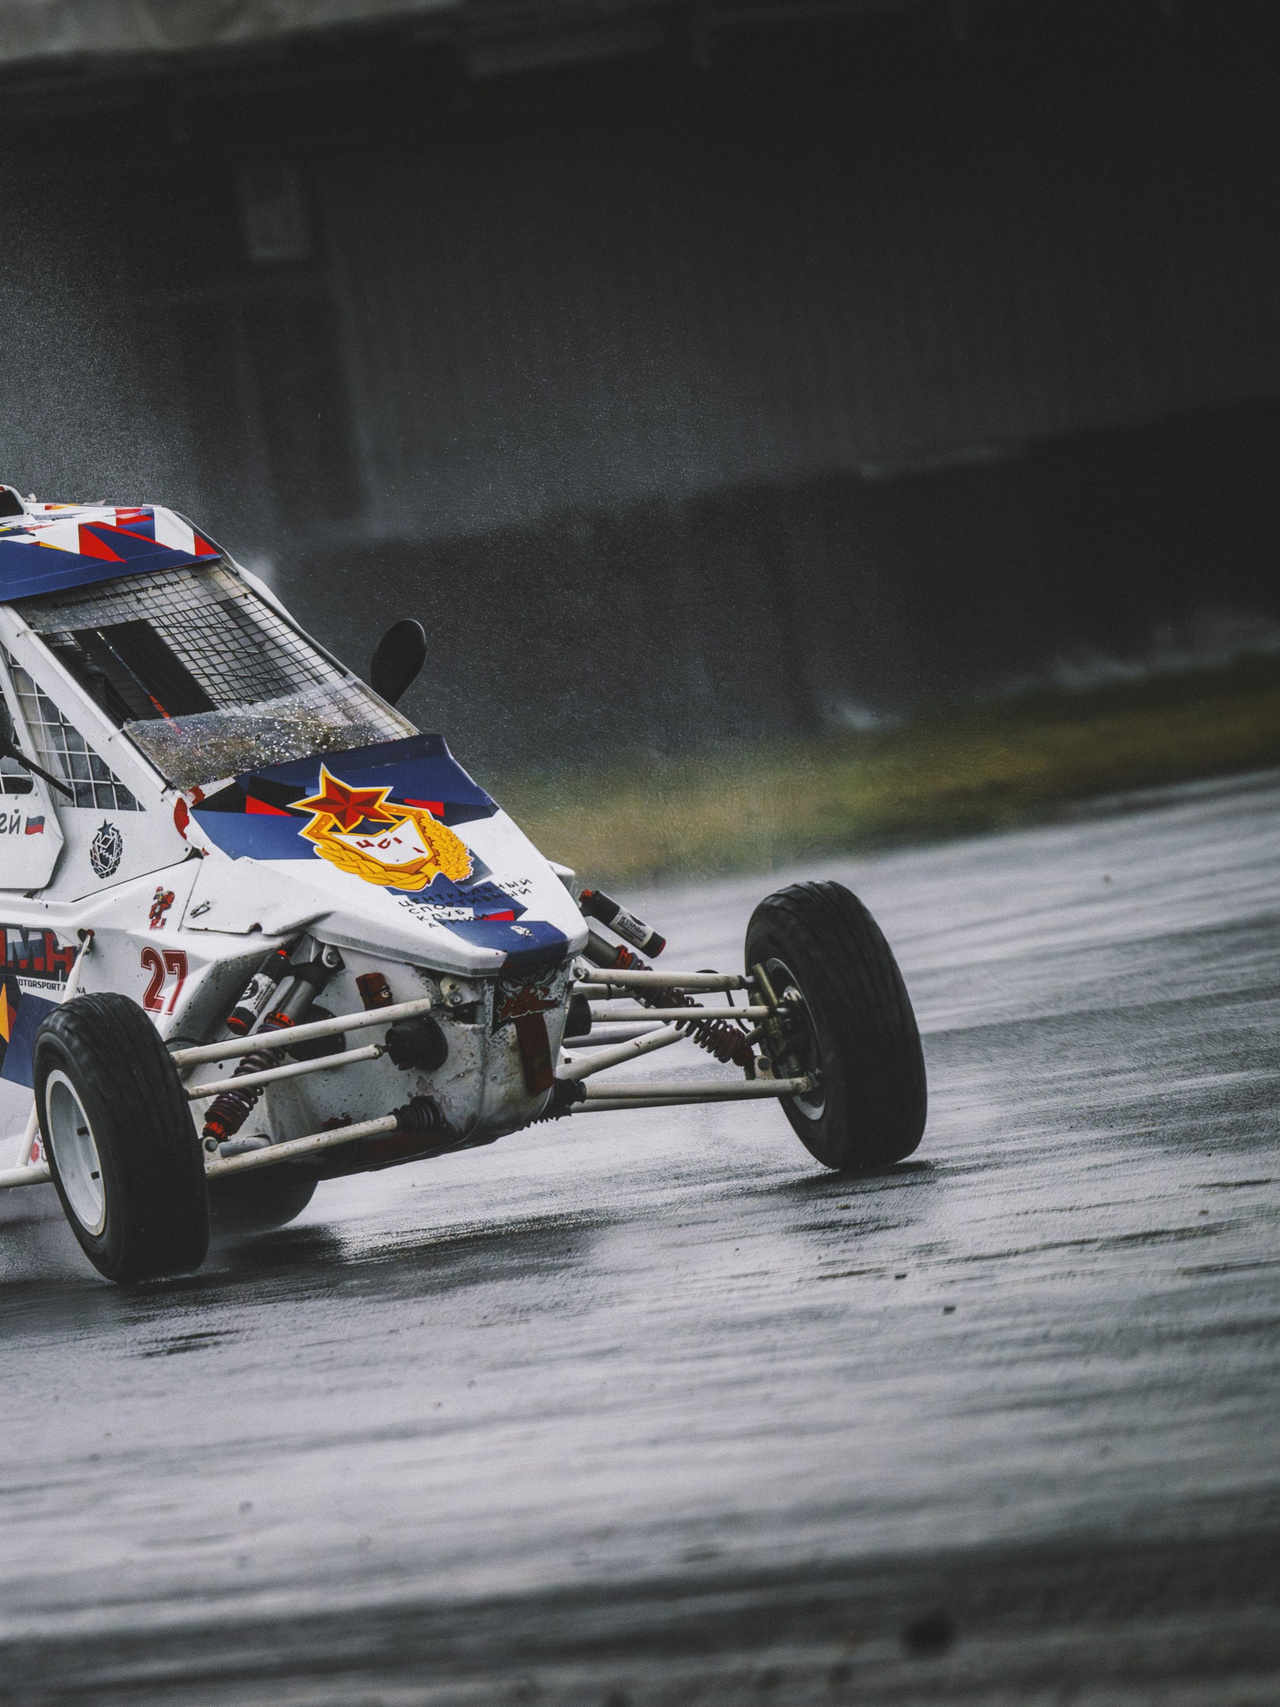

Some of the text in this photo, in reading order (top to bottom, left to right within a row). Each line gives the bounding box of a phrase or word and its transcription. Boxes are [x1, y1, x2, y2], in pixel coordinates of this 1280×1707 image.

[416, 909, 466, 922] КЛУБ
[18, 978, 86, 995] OTORSPORT ANA
[141, 946, 188, 1015] 27
